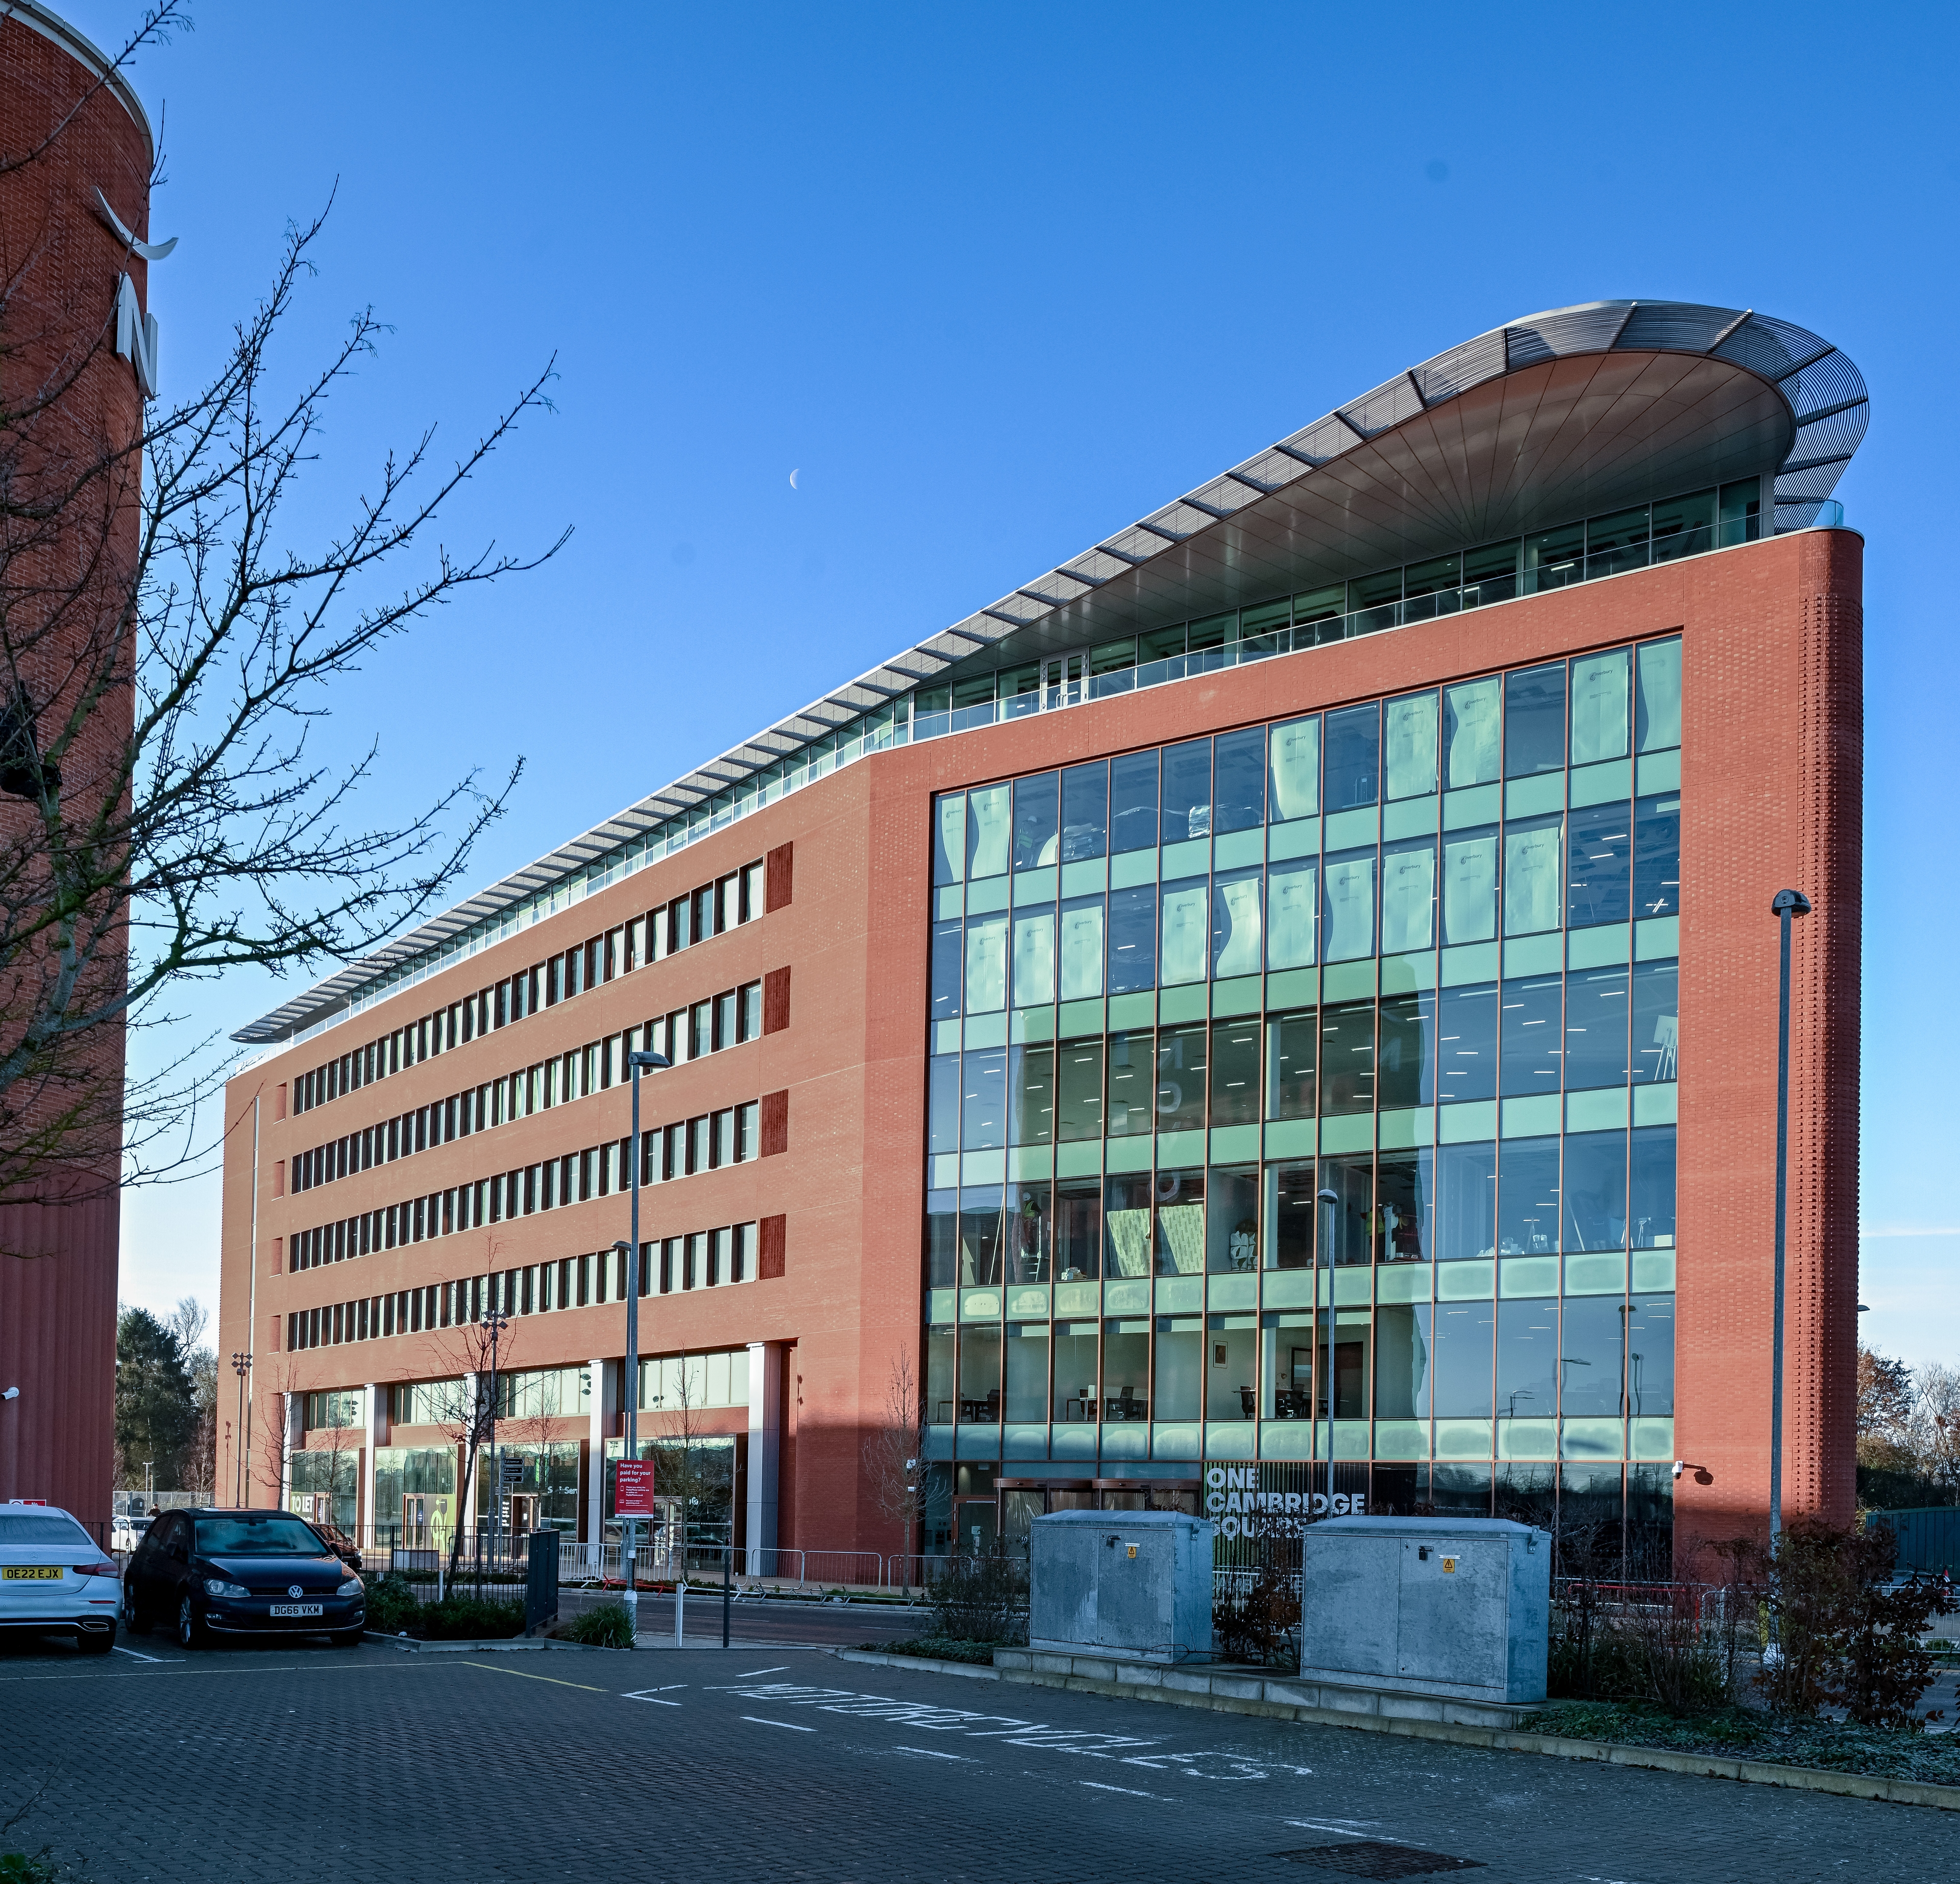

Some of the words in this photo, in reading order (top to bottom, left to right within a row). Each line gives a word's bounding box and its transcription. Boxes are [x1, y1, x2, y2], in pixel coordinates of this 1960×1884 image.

[1207, 1467, 1259, 1489] ONE
[291, 1496, 301, 1512] TO
[302, 1496, 313, 1512] LET
[1207, 1492, 1365, 1515] CAMBRIDGE
[7, 1569, 35, 1578] OE22
[38, 1569, 59, 1578] EJX
[275, 1606, 299, 1614] DG66
[302, 1605, 319, 1614] VKM
[702, 1683, 1313, 1779] MOTORCYCLES
